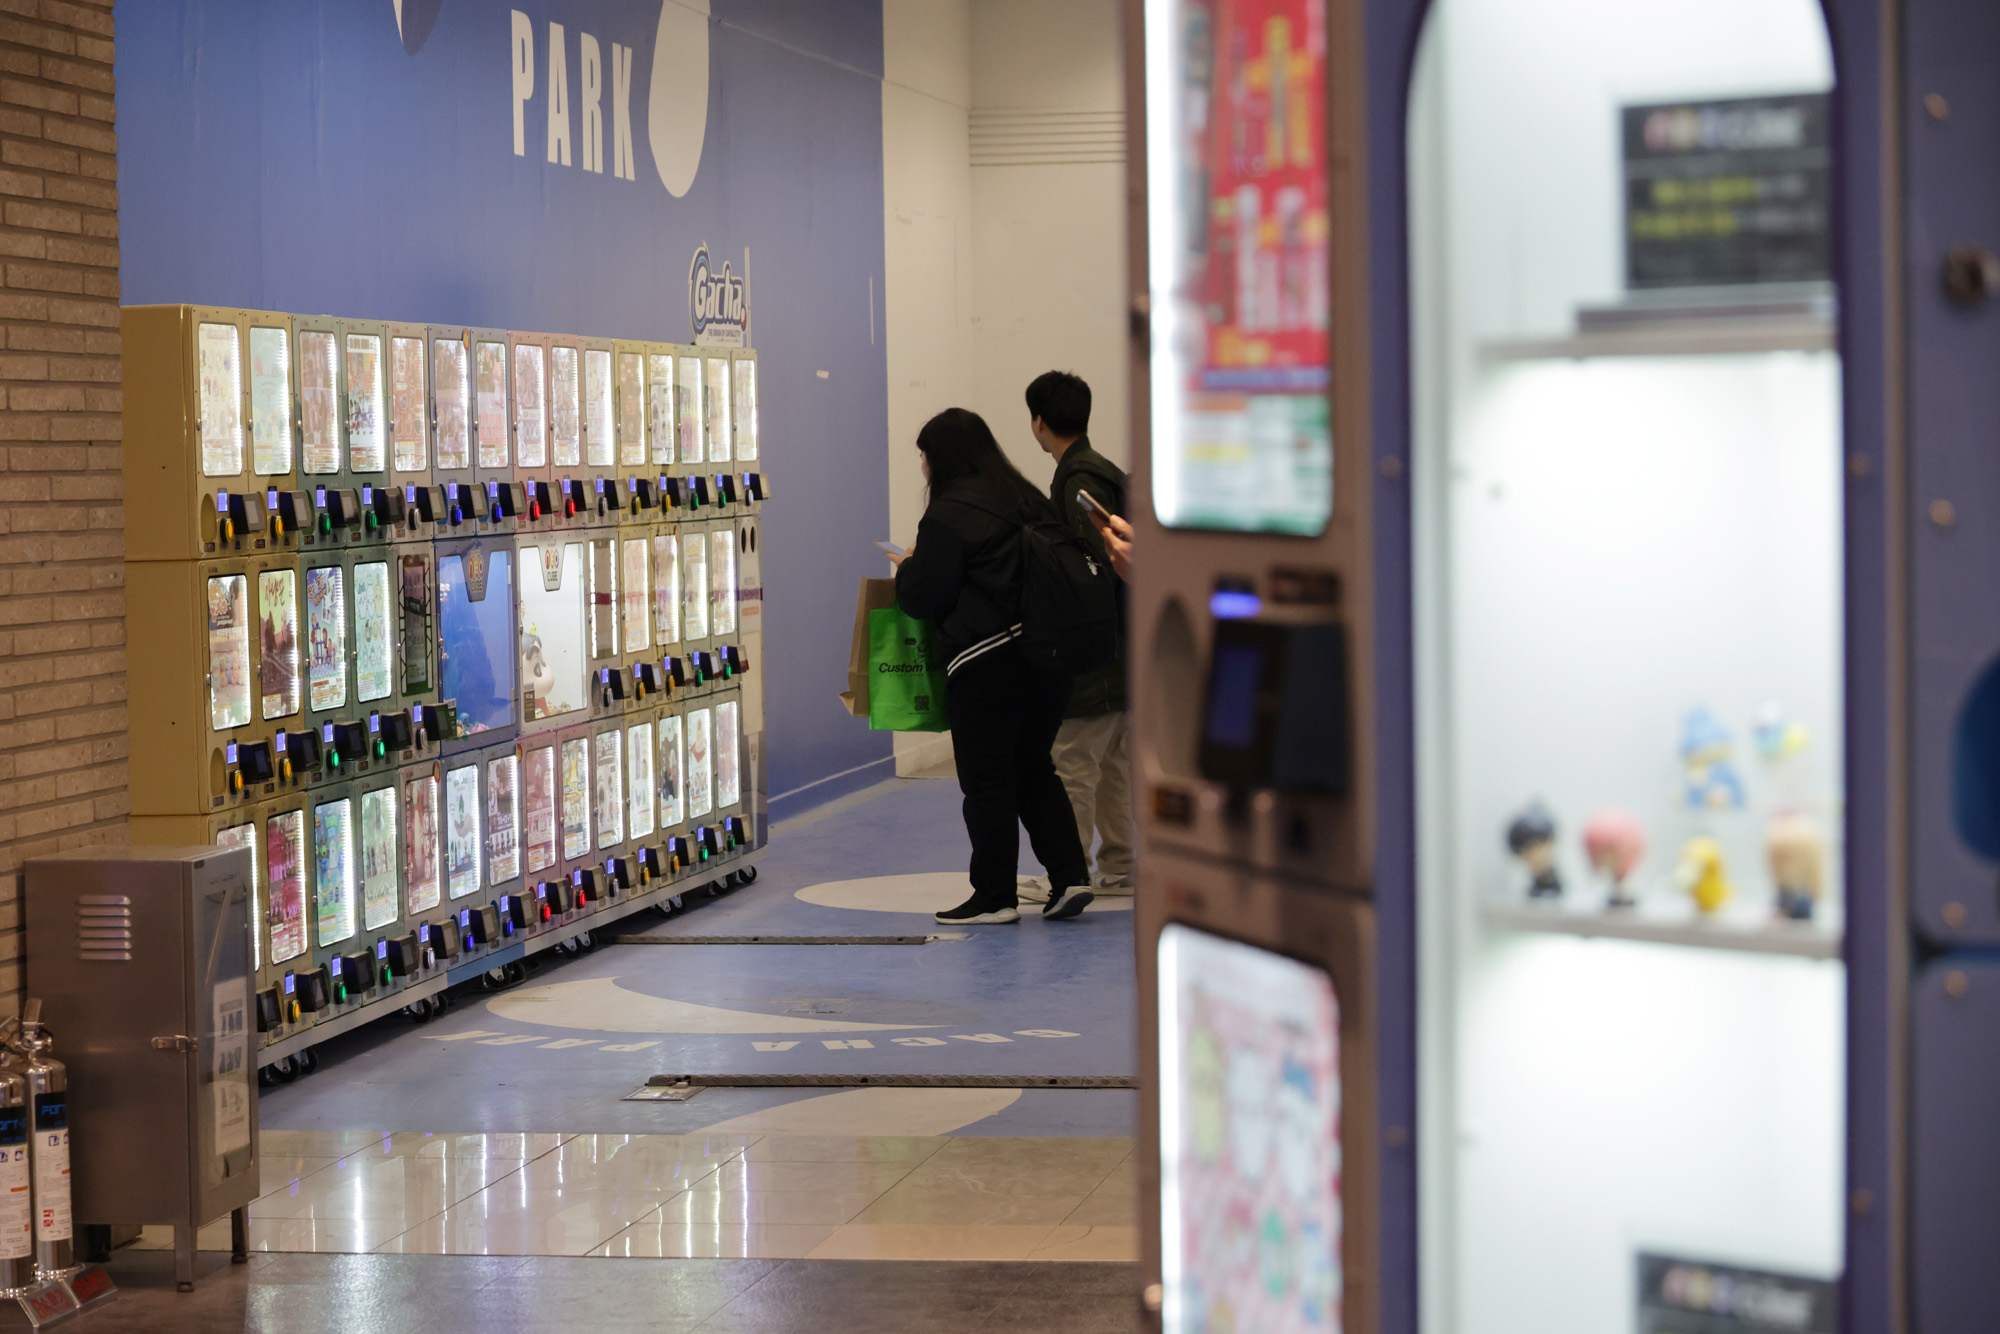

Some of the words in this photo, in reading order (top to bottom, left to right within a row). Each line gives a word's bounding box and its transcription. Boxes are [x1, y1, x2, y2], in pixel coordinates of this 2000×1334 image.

[511, 8, 636, 181] PARK
[879, 662, 923, 673] Custom
[420, 1030, 663, 1052] PARK
[751, 1029, 1081, 1052] GACHA
